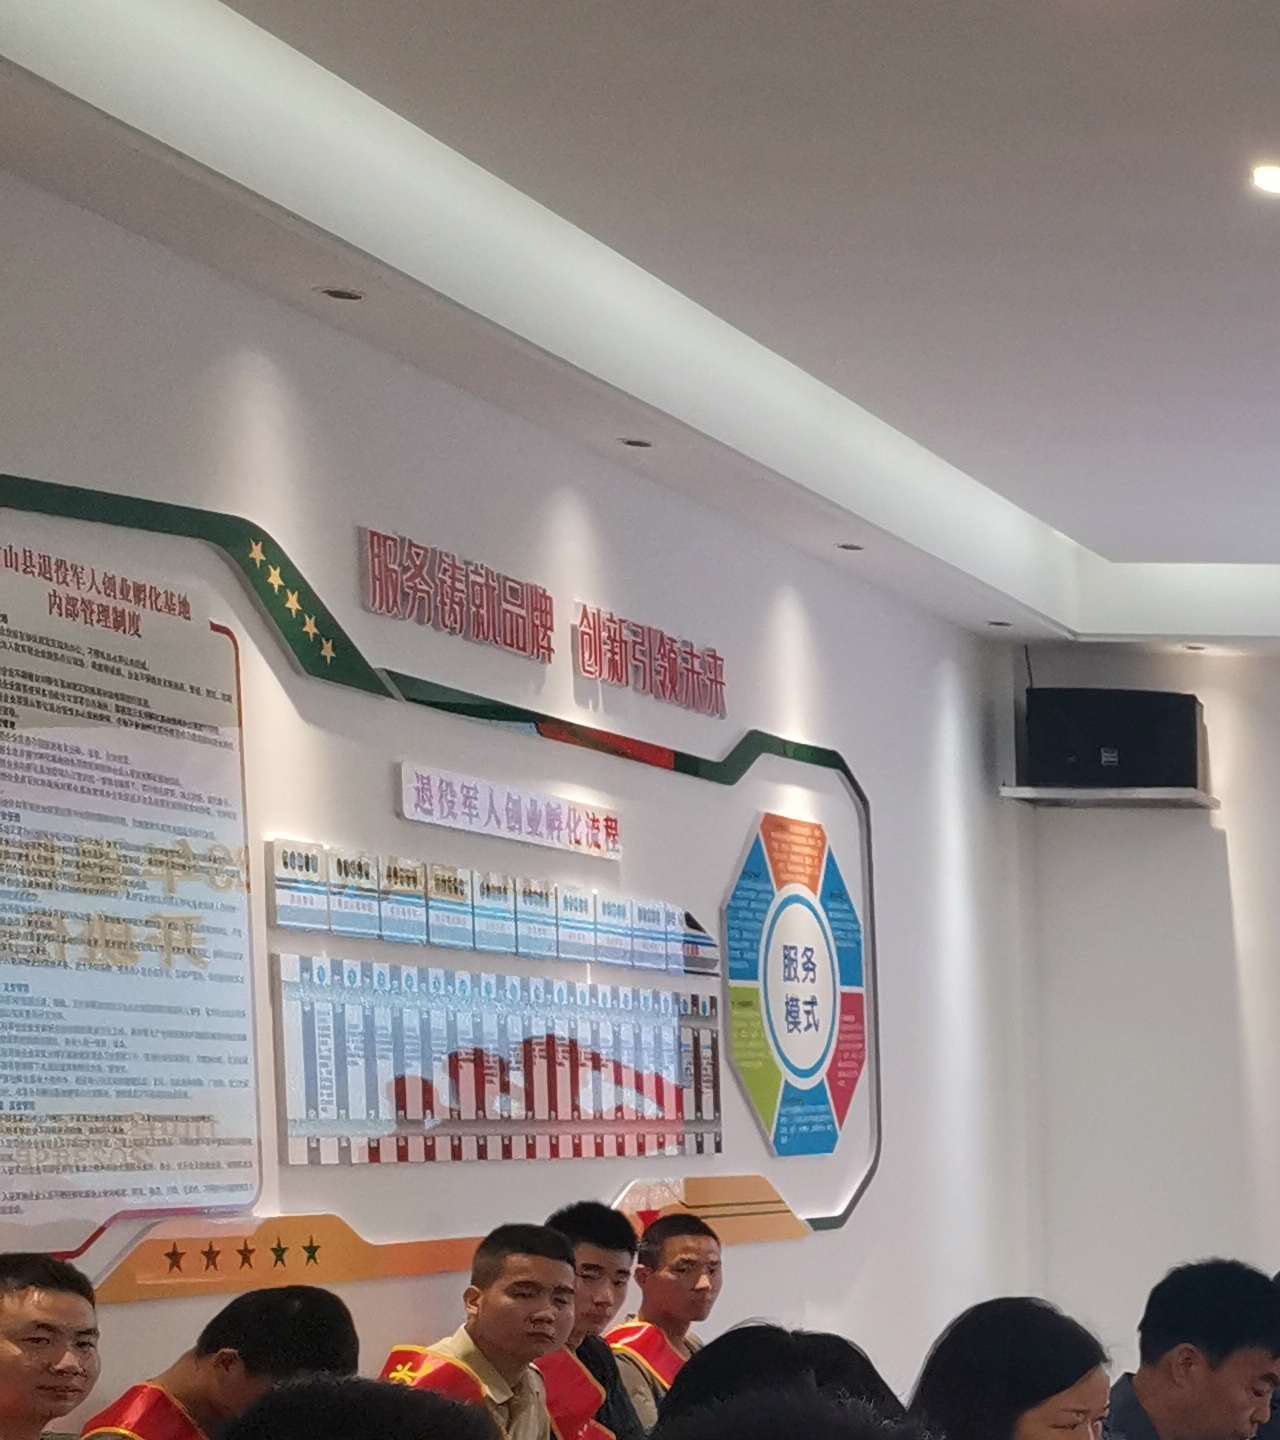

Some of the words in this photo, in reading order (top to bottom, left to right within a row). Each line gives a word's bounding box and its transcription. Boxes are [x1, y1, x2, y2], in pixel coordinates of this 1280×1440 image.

[0, 543, 191, 621] 山县退役军人创业孵化基地
[369, 529, 556, 664] 服务铸就品牌
[579, 604, 727, 718] 创新引领未来
[783, 945, 817, 983] 服务
[785, 992, 819, 1034] 模式
